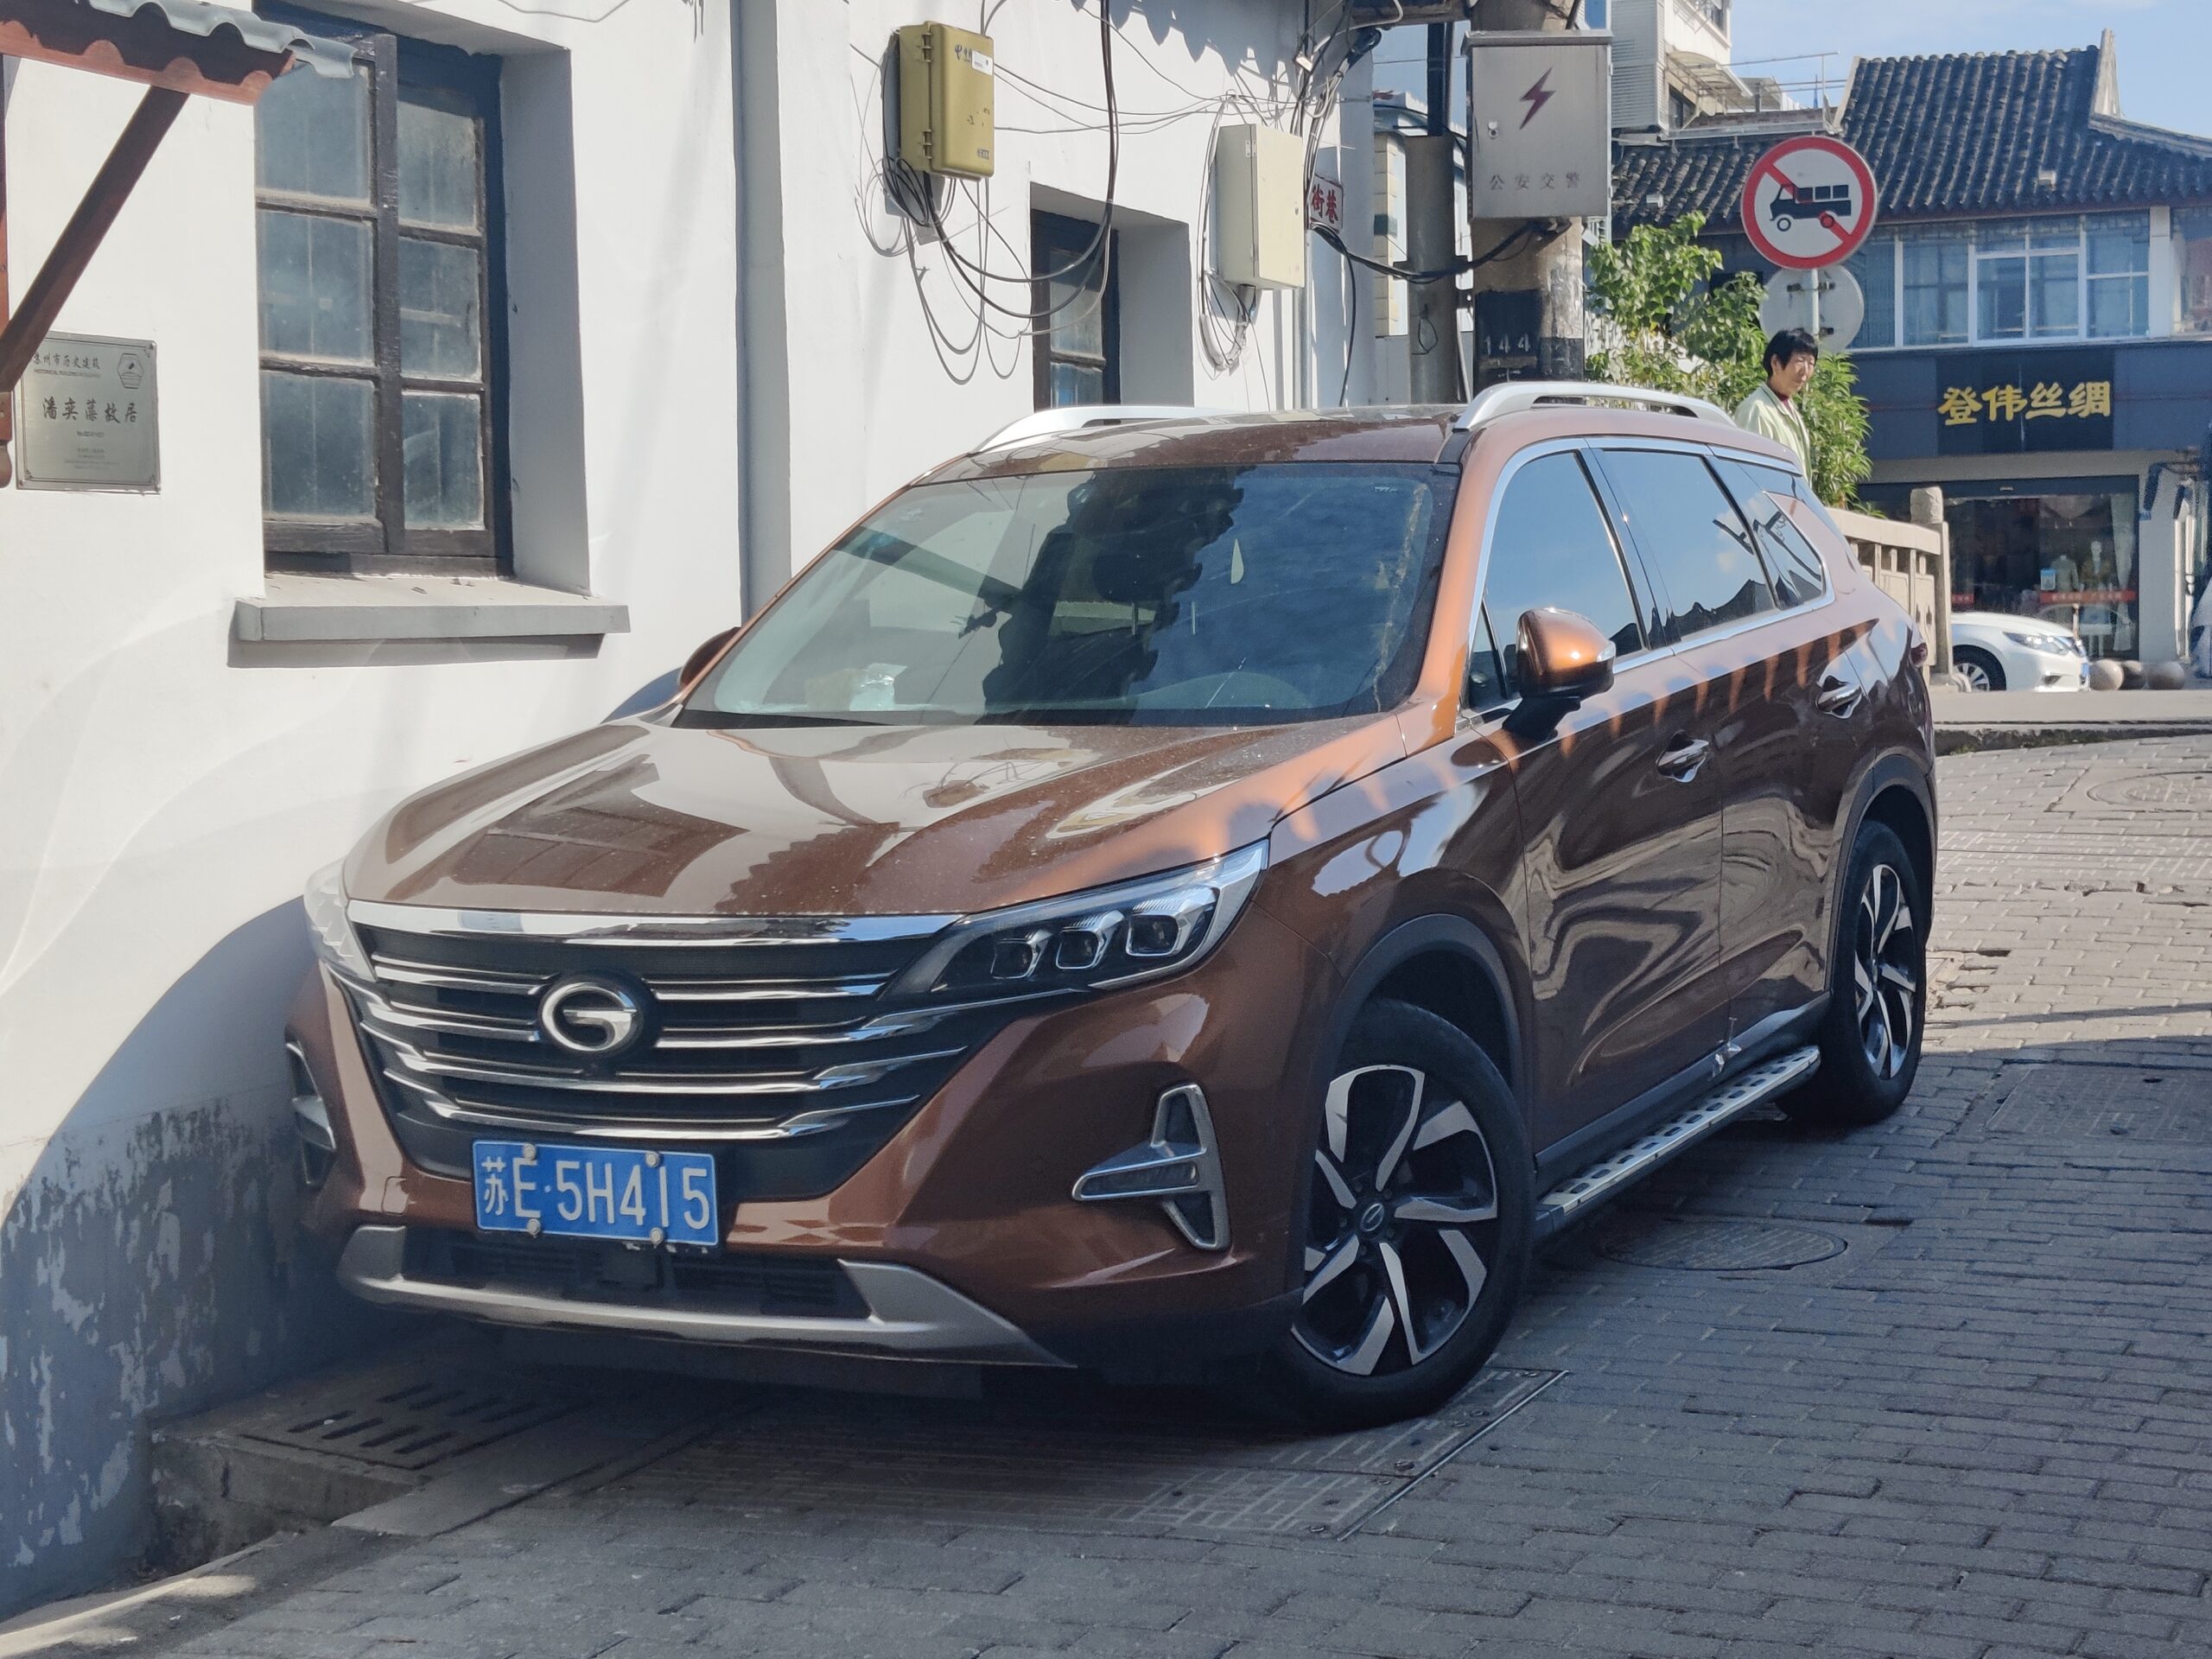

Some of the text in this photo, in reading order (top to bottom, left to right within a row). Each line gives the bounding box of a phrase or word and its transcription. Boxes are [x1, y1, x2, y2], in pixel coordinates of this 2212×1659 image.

[1491, 173, 1580, 190] 公安交警
[1937, 380, 2111, 426] 登伟丝绸
